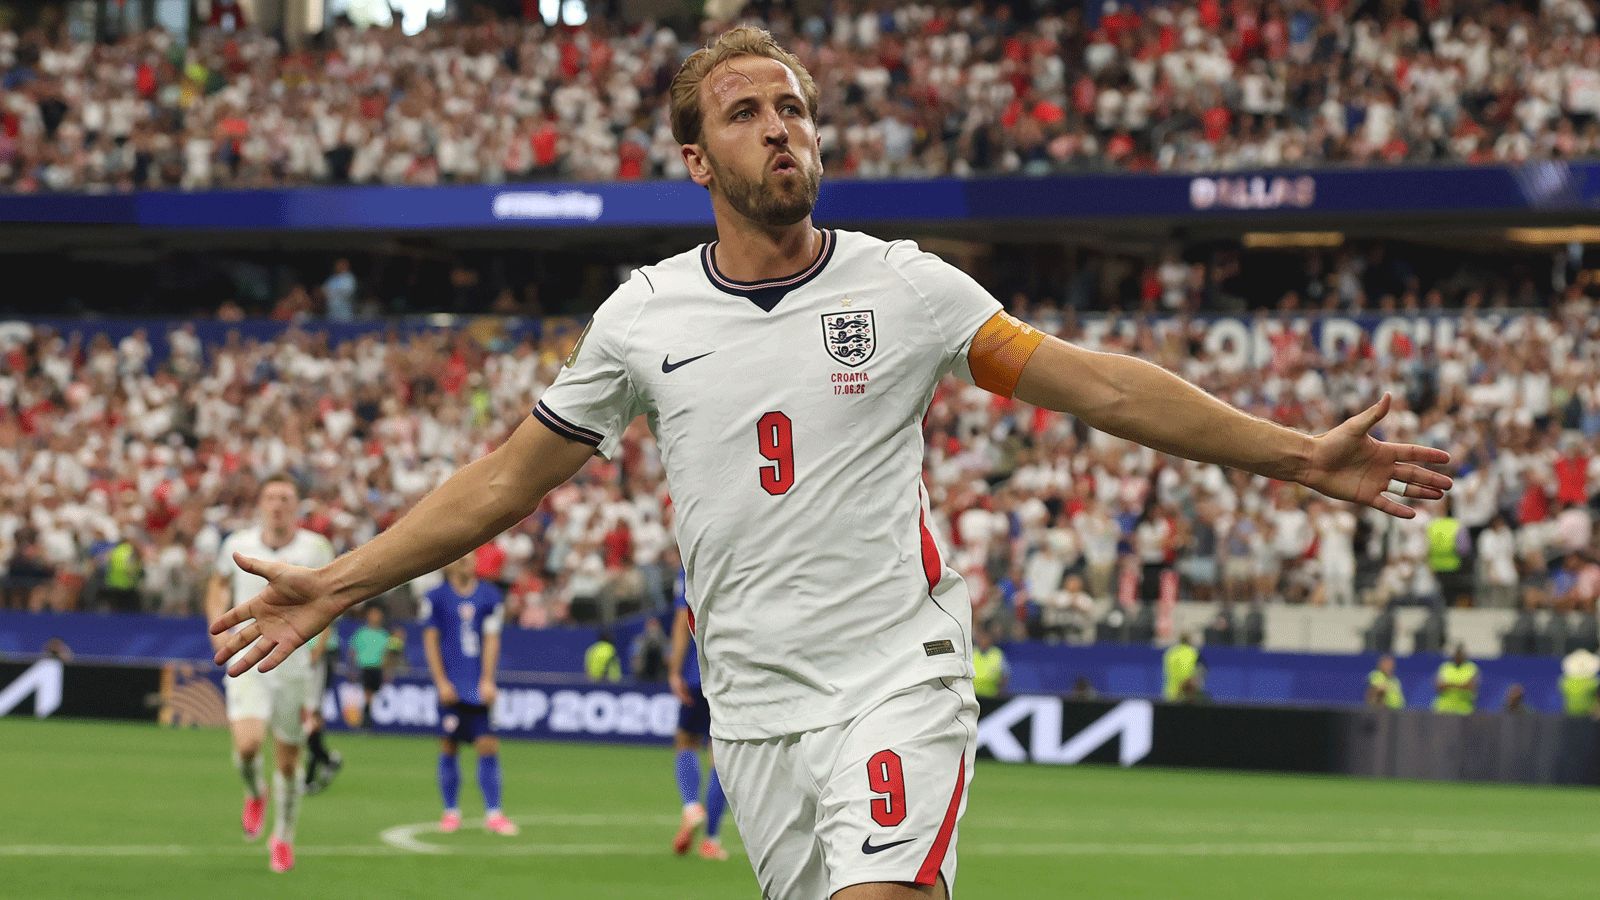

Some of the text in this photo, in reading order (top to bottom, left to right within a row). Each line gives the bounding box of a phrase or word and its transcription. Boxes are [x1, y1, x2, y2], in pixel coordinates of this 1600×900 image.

[831, 372, 869, 382] CROATIA
[834, 384, 865, 395] 17.06.26
[757, 411, 794, 496] 9
[491, 688, 548, 731] UP
[550, 689, 681, 736] 2026
[866, 749, 907, 827] 9
